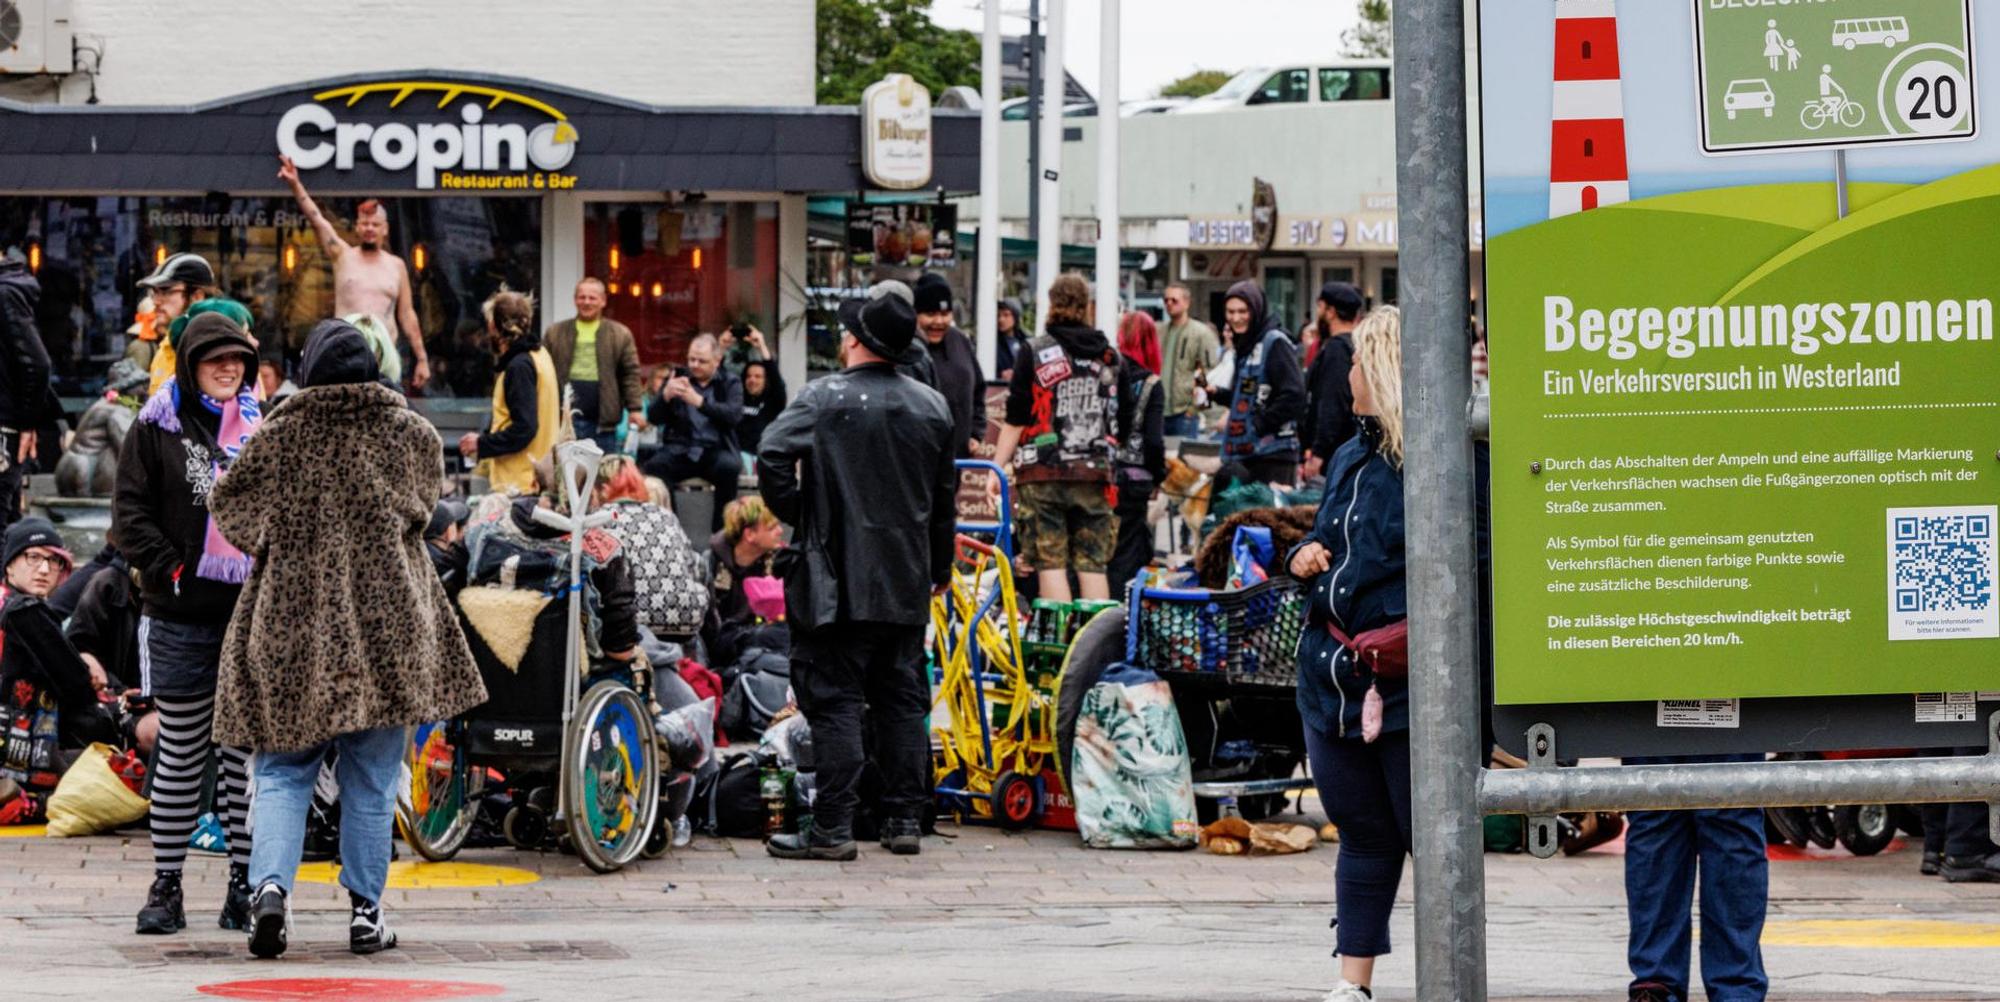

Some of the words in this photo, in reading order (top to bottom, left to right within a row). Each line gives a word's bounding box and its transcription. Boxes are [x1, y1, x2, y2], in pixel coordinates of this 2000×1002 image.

[1907, 75, 1957, 120] 20
[276, 103, 578, 189] Cropino
[441, 172, 528, 188] Restaurant
[532, 172, 544, 188] &
[548, 172, 577, 188] Bar
[150, 209, 249, 227] Restaurant
[255, 209, 267, 227] &
[1544, 296, 1992, 360] Begegnungszonen
[1544, 370, 1574, 395] Ein
[1579, 365, 1752, 394] Verkehrsversuch
[1758, 366, 1776, 389] in
[1782, 361, 1900, 388] Westerland
[1545, 457, 1585, 470] Durch
[1589, 457, 1612, 469] das
[1615, 455, 1688, 468] Abschalten
[1692, 454, 1714, 466] der
[1718, 453, 1768, 467] Ampeln
[1773, 452, 1797, 464] und
[1802, 452, 1829, 463] eine
[1833, 449, 1893, 463] auffällige
[1897, 448, 1973, 461] Markierung
[1545, 480, 1567, 492] der
[1570, 477, 1676, 491] Verkehrsflächen
[1680, 476, 1737, 488] wachsen
[1742, 474, 1761, 486] die
[1766, 473, 1875, 488] Fußgängerzonen
[1879, 470, 1927, 485] optisch
[1931, 469, 1952, 481] mit
[1956, 469, 1978, 480] der
[1546, 501, 1588, 513] Straße
[1592, 499, 1666, 512] zusammen.
[1546, 537, 1567, 549] Als
[1571, 536, 1619, 550] Symbol
[1623, 535, 1642, 547] für
[1645, 534, 1665, 546] die
[1669, 533, 1743, 548] gemeinsam
[1747, 532, 1813, 546] genutzten
[1547, 557, 1653, 570] Verkehrsflächen
[1657, 556, 1702, 567] dienen
[1705, 554, 1751, 568] farbige
[1756, 552, 1802, 565] Punkte
[1806, 551, 1844, 563] sowie
[1547, 581, 1575, 592] eine
[1579, 578, 1651, 592] zusätzliche
[1656, 576, 1751, 590] Beschilderung.
[1548, 616, 1571, 628] Die
[1574, 614, 1636, 628] zulässige
[1639, 609, 1797, 627] Höchstgeschwindigkeit
[1800, 608, 1851, 623] beträgt
[1548, 637, 1561, 650] in
[1564, 636, 1609, 649] diesen
[1611, 635, 1681, 648] Bereichen
[1683, 634, 1702, 646] 20
[1703, 632, 1743, 645] km/h.
[494, 728, 535, 741] SOPUR
